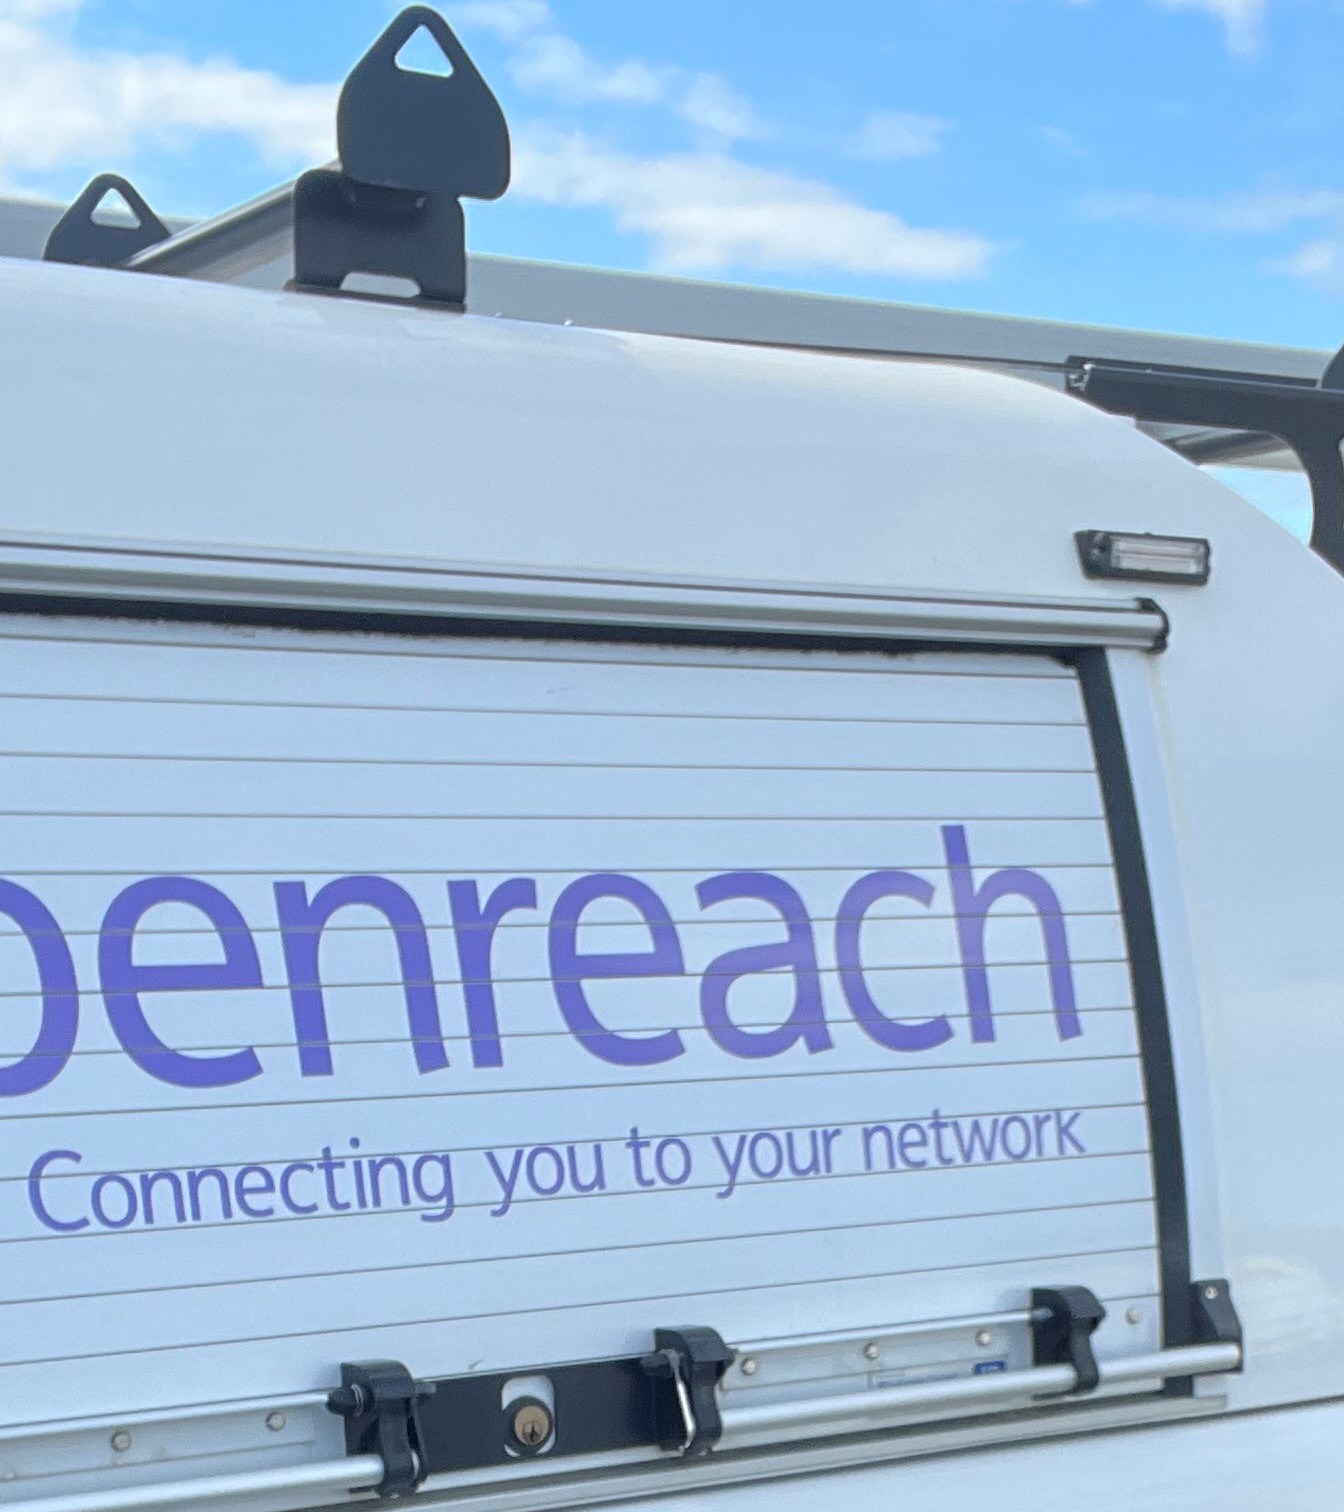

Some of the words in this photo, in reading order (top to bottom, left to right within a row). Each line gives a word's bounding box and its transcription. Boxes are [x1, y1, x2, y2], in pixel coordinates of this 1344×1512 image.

[28, 1137, 456, 1232] Connecting
[485, 1143, 606, 1217] you
[626, 1127, 692, 1187] to
[712, 1127, 842, 1199] your
[862, 1109, 1086, 1172] network
